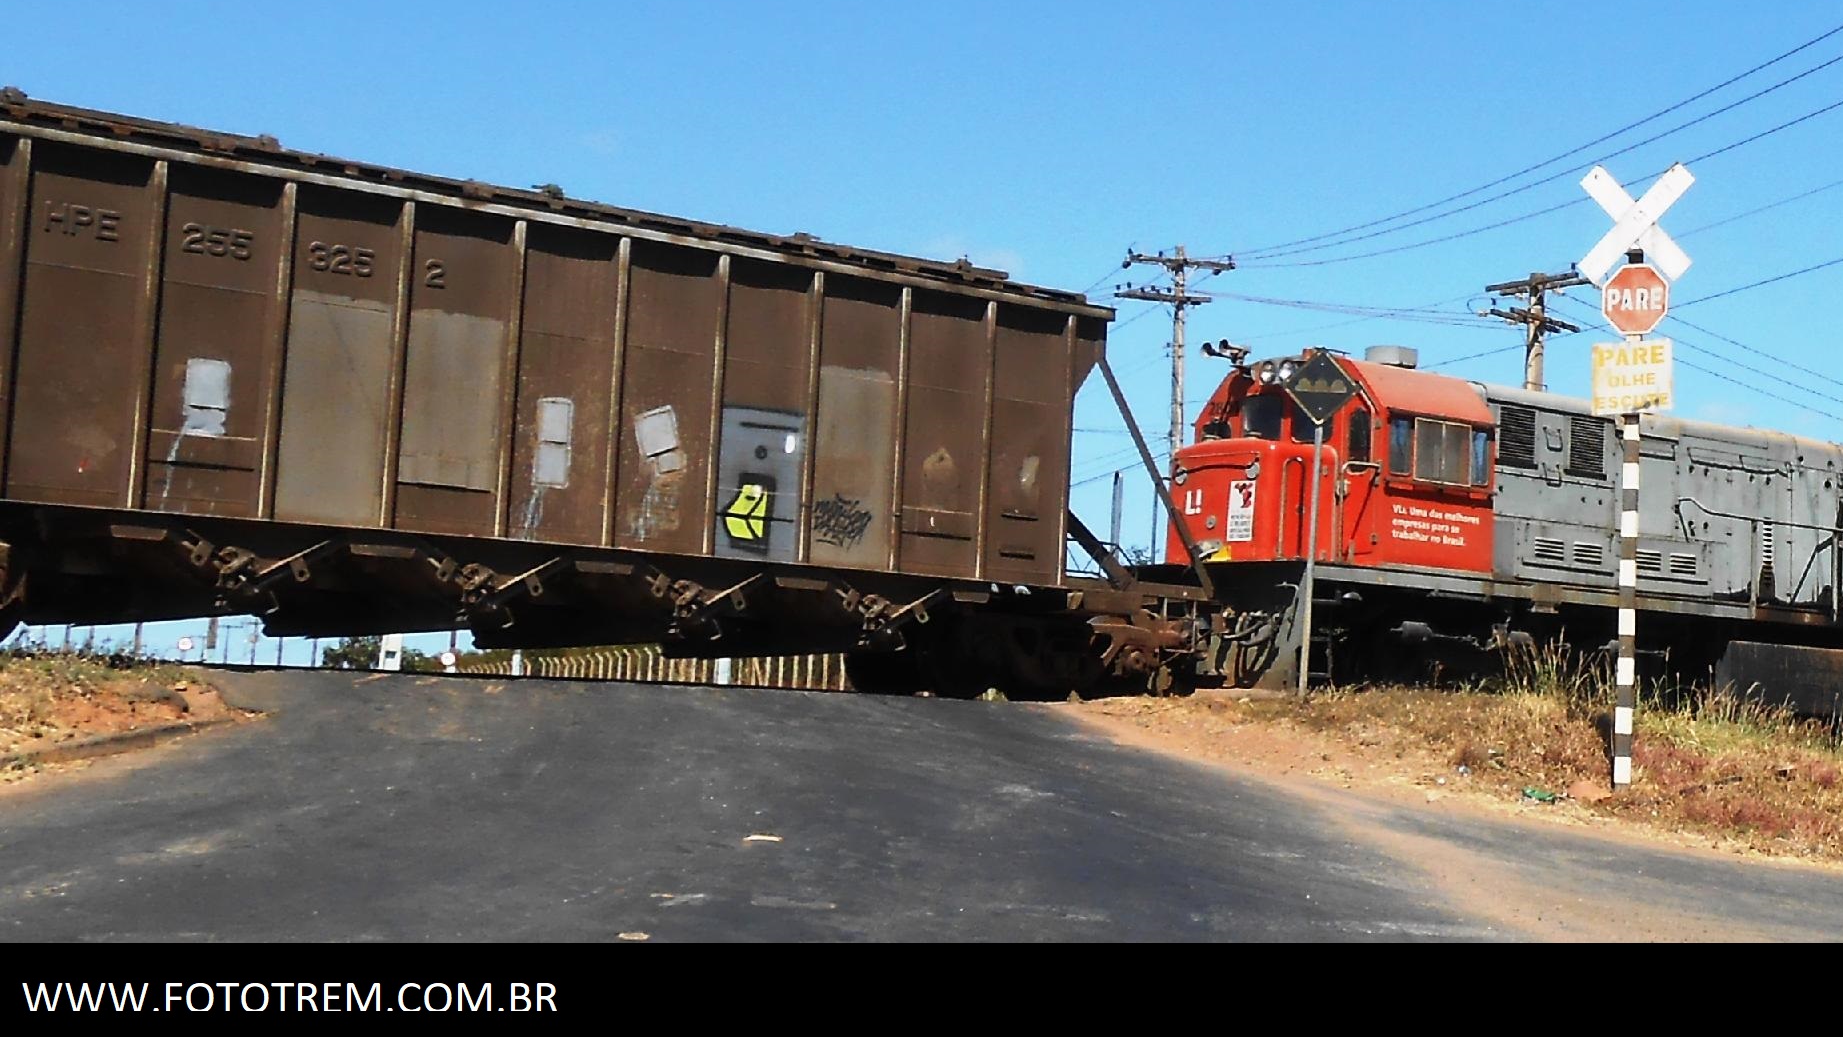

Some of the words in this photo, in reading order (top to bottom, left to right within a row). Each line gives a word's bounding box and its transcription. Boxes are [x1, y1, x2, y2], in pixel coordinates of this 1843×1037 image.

[43, 200, 121, 242] HPE
[182, 222, 254, 261] 255
[308, 240, 376, 278] 325
[424, 258, 446, 289] 2
[1607, 287, 1664, 311] PARE
[1598, 345, 1665, 367] PARE
[1607, 372, 1656, 387] OLHE
[1594, 393, 1669, 412] ESCUTE
[1392, 518, 1430, 530] empresas
[1444, 512, 1480, 525] melhores
[1392, 529, 1429, 542] trabalhar
